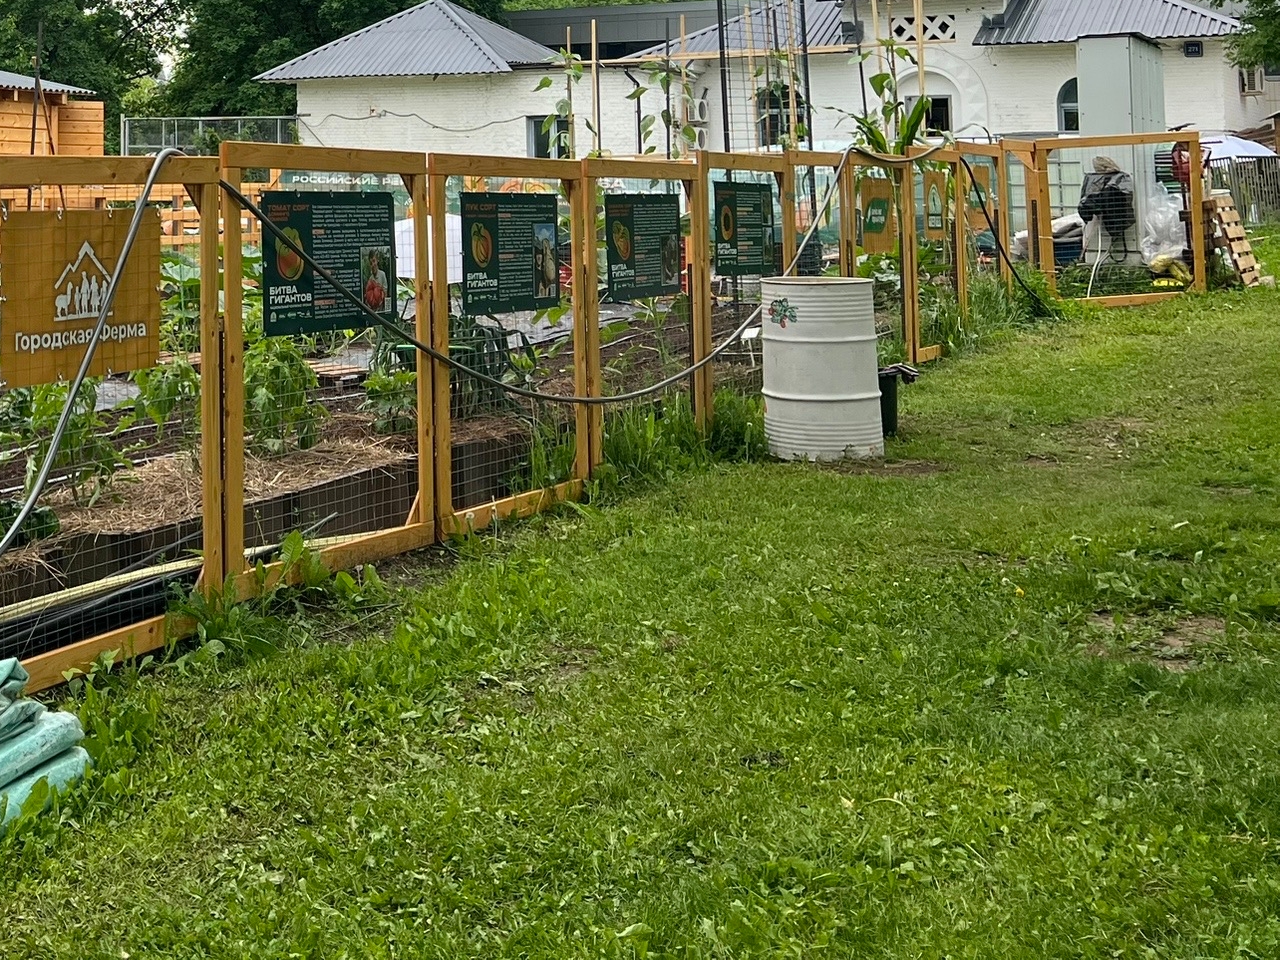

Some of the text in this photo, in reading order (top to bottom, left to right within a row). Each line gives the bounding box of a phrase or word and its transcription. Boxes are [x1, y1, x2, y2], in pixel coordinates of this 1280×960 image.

[292, 174, 379, 186] РОССИЙСКИЕ
[267, 204, 310, 212] ТОМАТ СОРТ
[480, 203, 497, 211] СОРТ
[466, 272, 488, 280] БИТВА
[466, 279, 498, 289] ГИГАНТОВ
[269, 285, 298, 295] БИТВА
[269, 293, 313, 305] ГИГАНТОВ
[14, 322, 147, 354] Городская Ферма
